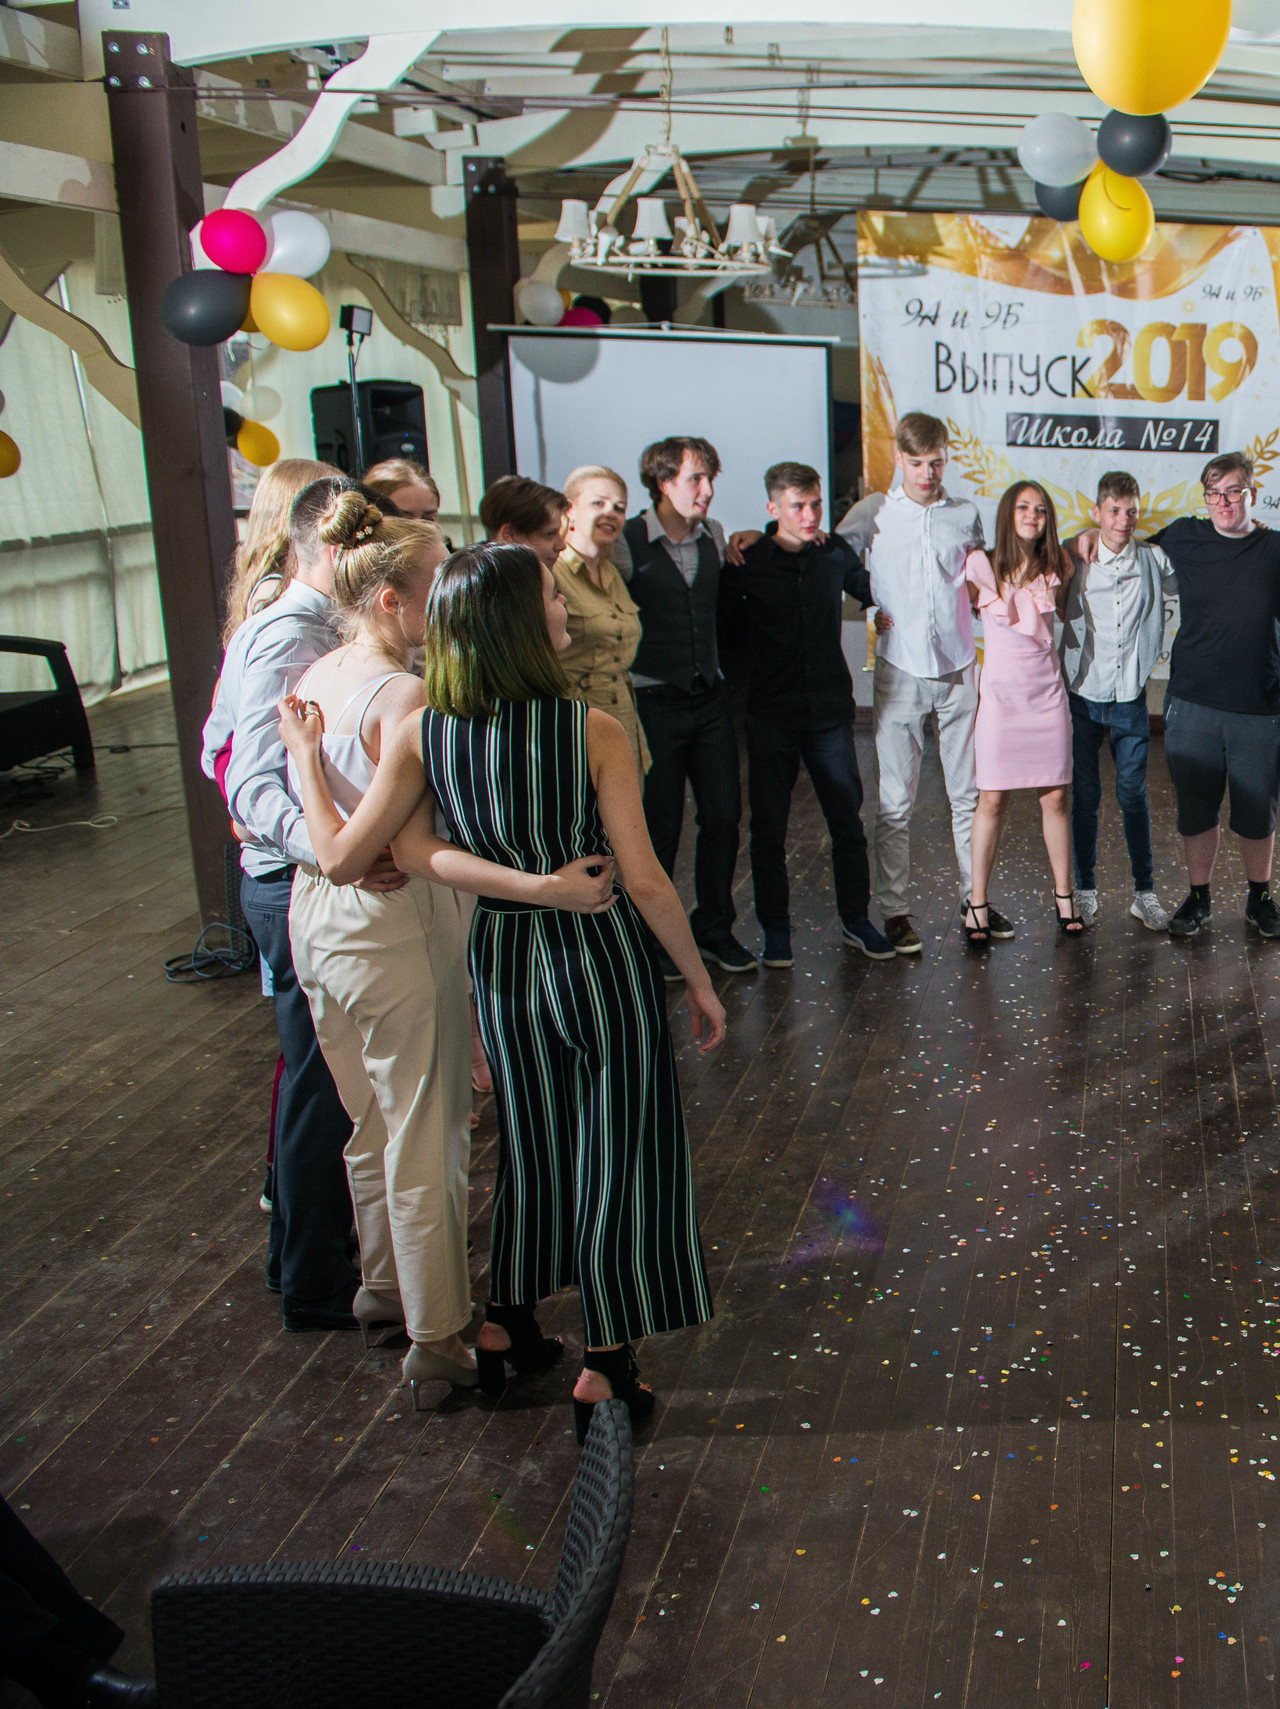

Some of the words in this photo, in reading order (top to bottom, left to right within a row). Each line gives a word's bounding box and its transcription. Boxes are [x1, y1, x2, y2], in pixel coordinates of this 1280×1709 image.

[979, 301, 1025, 330] 9Б
[1076, 318, 1259, 403] 2019
[1012, 415, 1126, 448] Школа
[1139, 419, 1214, 451] №14
